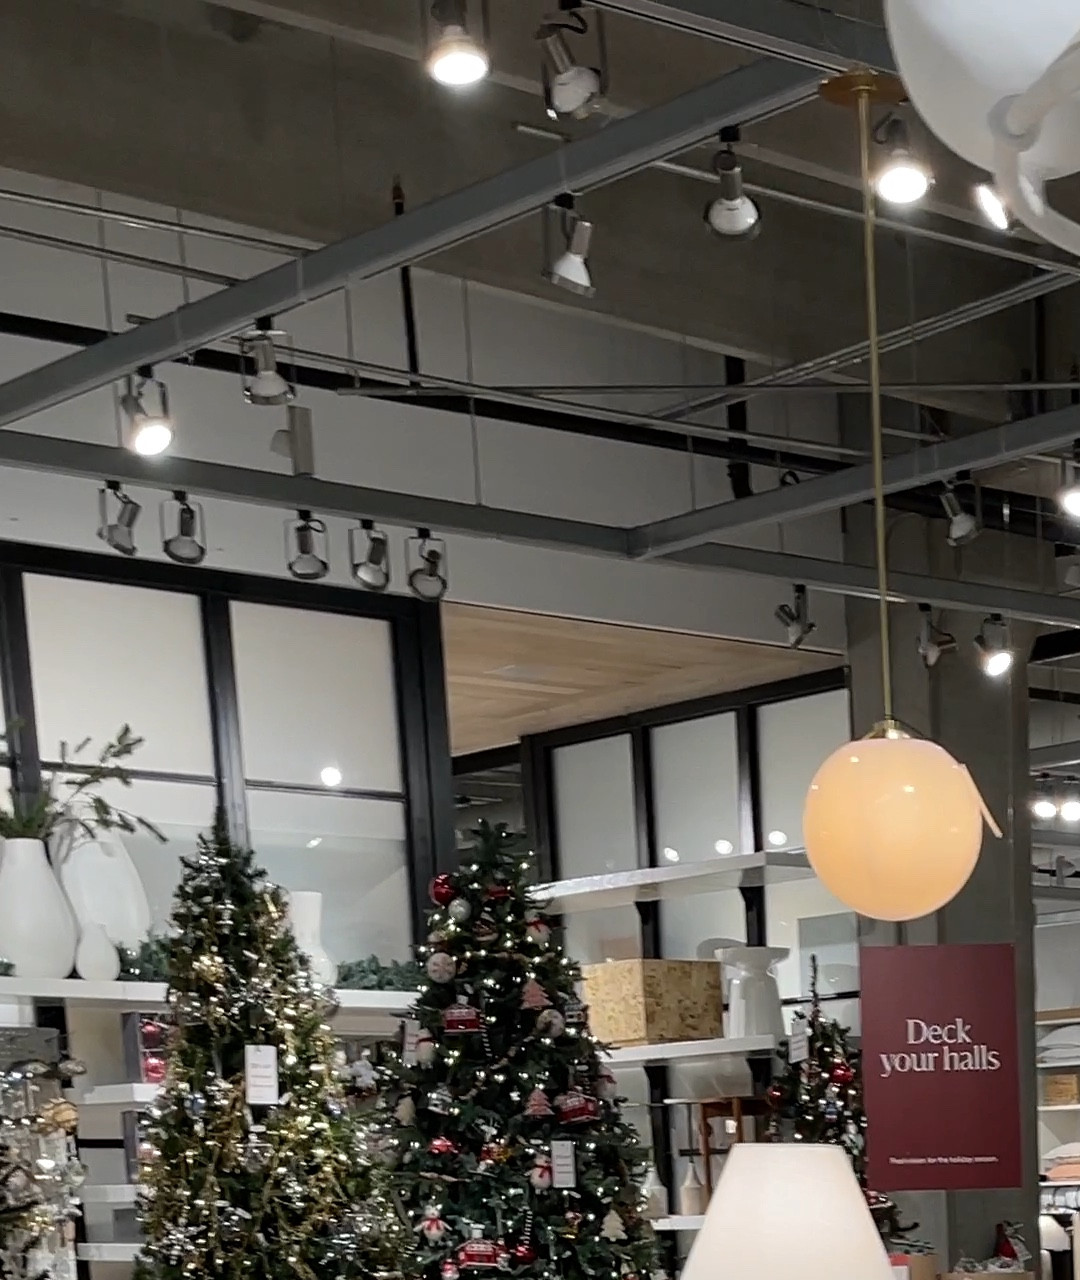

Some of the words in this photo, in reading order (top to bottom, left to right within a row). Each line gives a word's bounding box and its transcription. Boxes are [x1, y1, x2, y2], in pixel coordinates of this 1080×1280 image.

[905, 1017, 973, 1045] Deck
[879, 1053, 940, 1078] your
[942, 1045, 1001, 1071] halls
